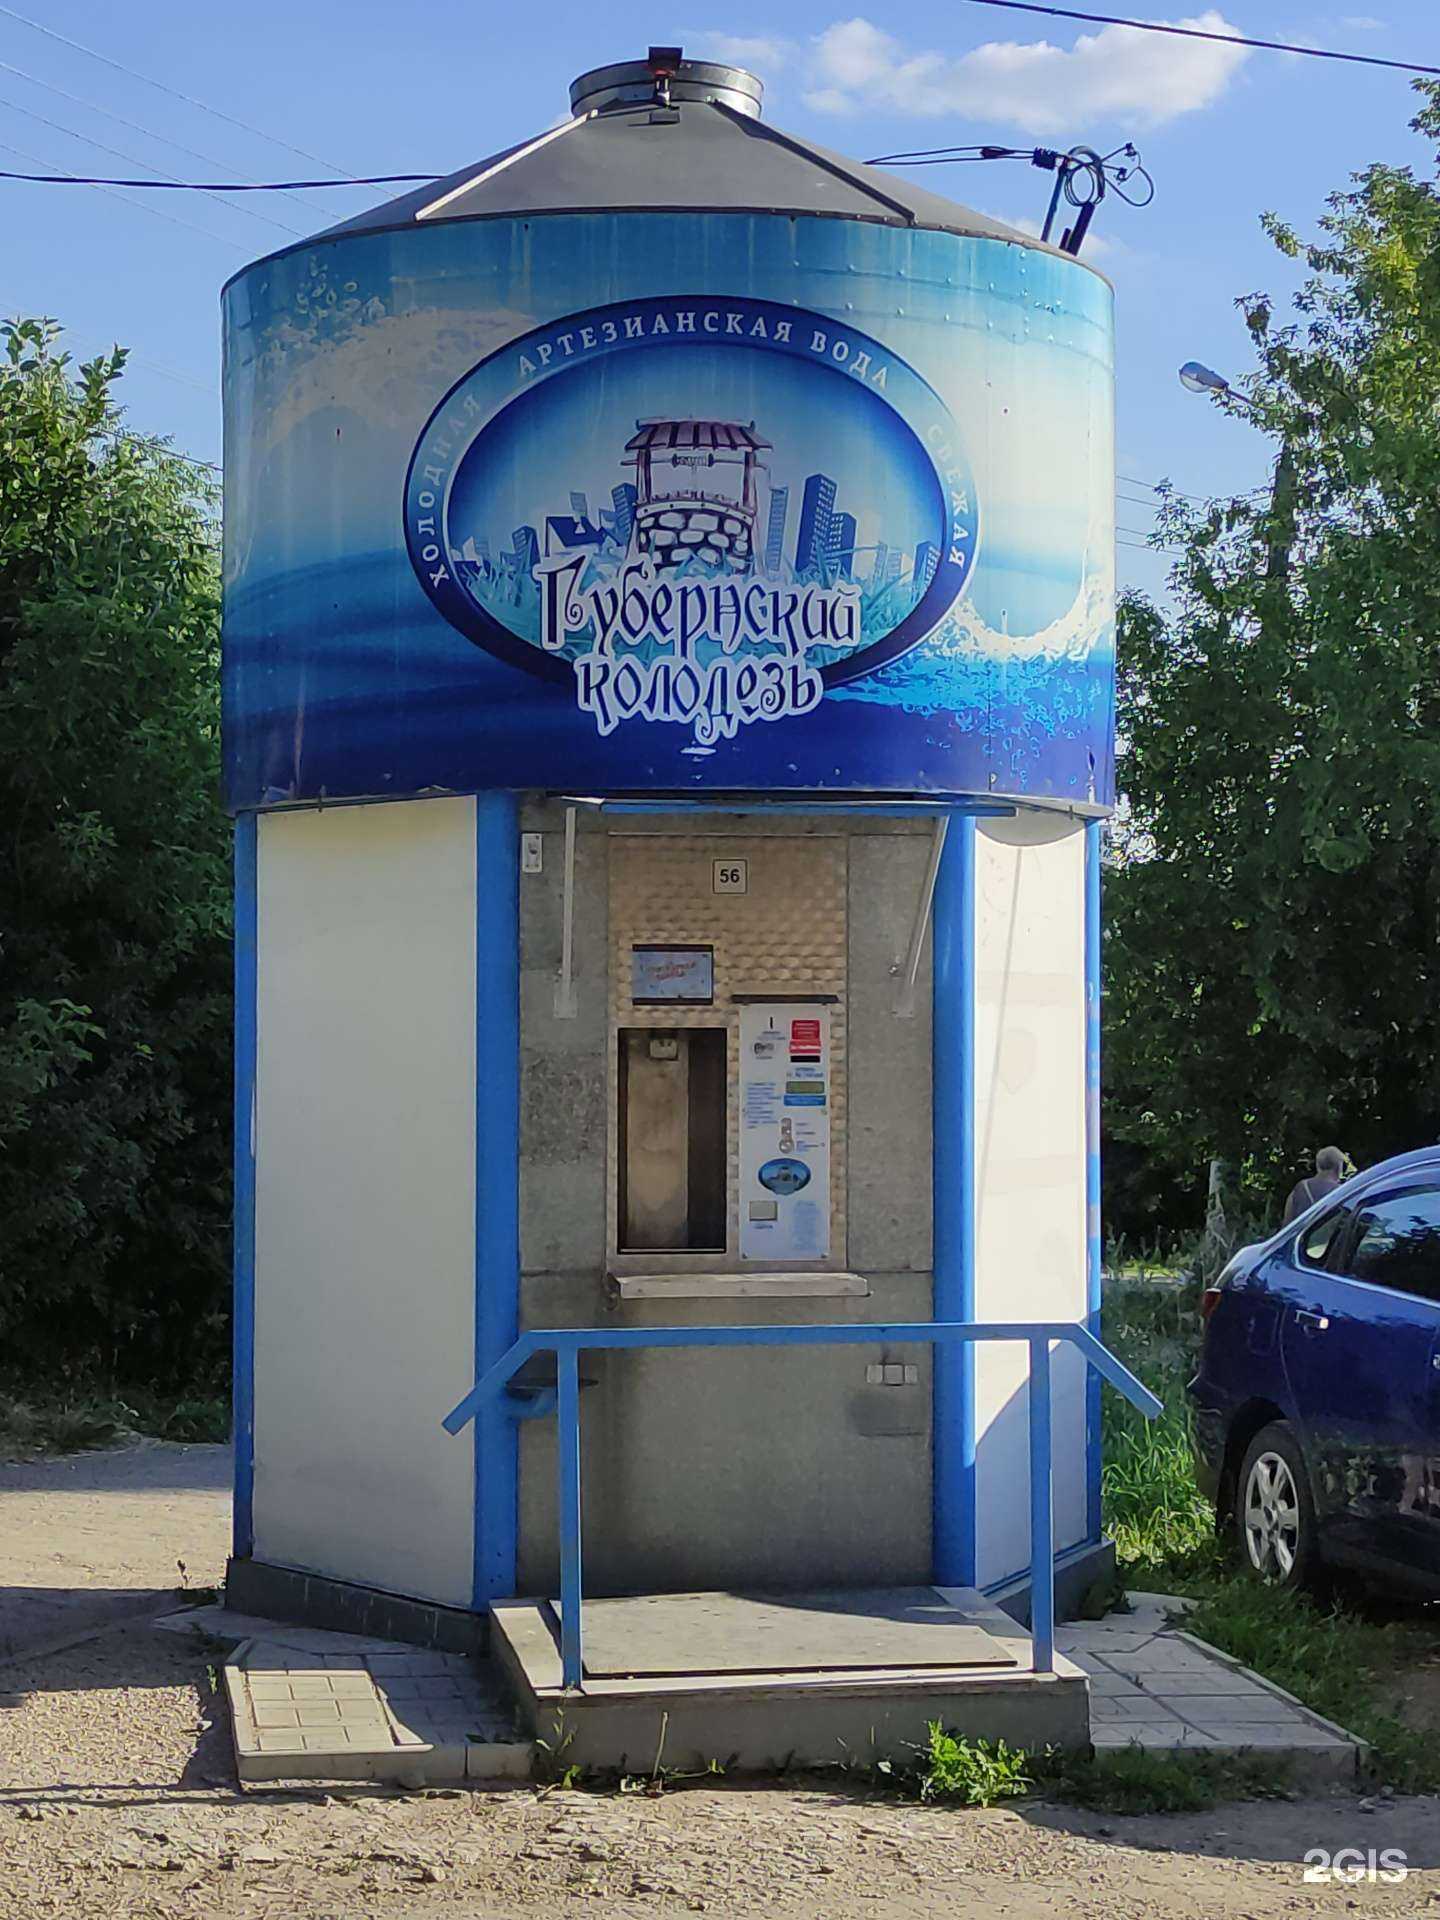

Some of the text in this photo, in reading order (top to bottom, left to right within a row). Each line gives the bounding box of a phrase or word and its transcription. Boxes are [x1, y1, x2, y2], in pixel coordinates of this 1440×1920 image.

[418, 394, 481, 589] ХОЛОДНАЯ
[517, 310, 794, 378] АРТЕЗИАНСКАЯ
[809, 330, 889, 389] ВОДА
[535, 552, 858, 660] Губернский
[719, 868, 740, 883] 56
